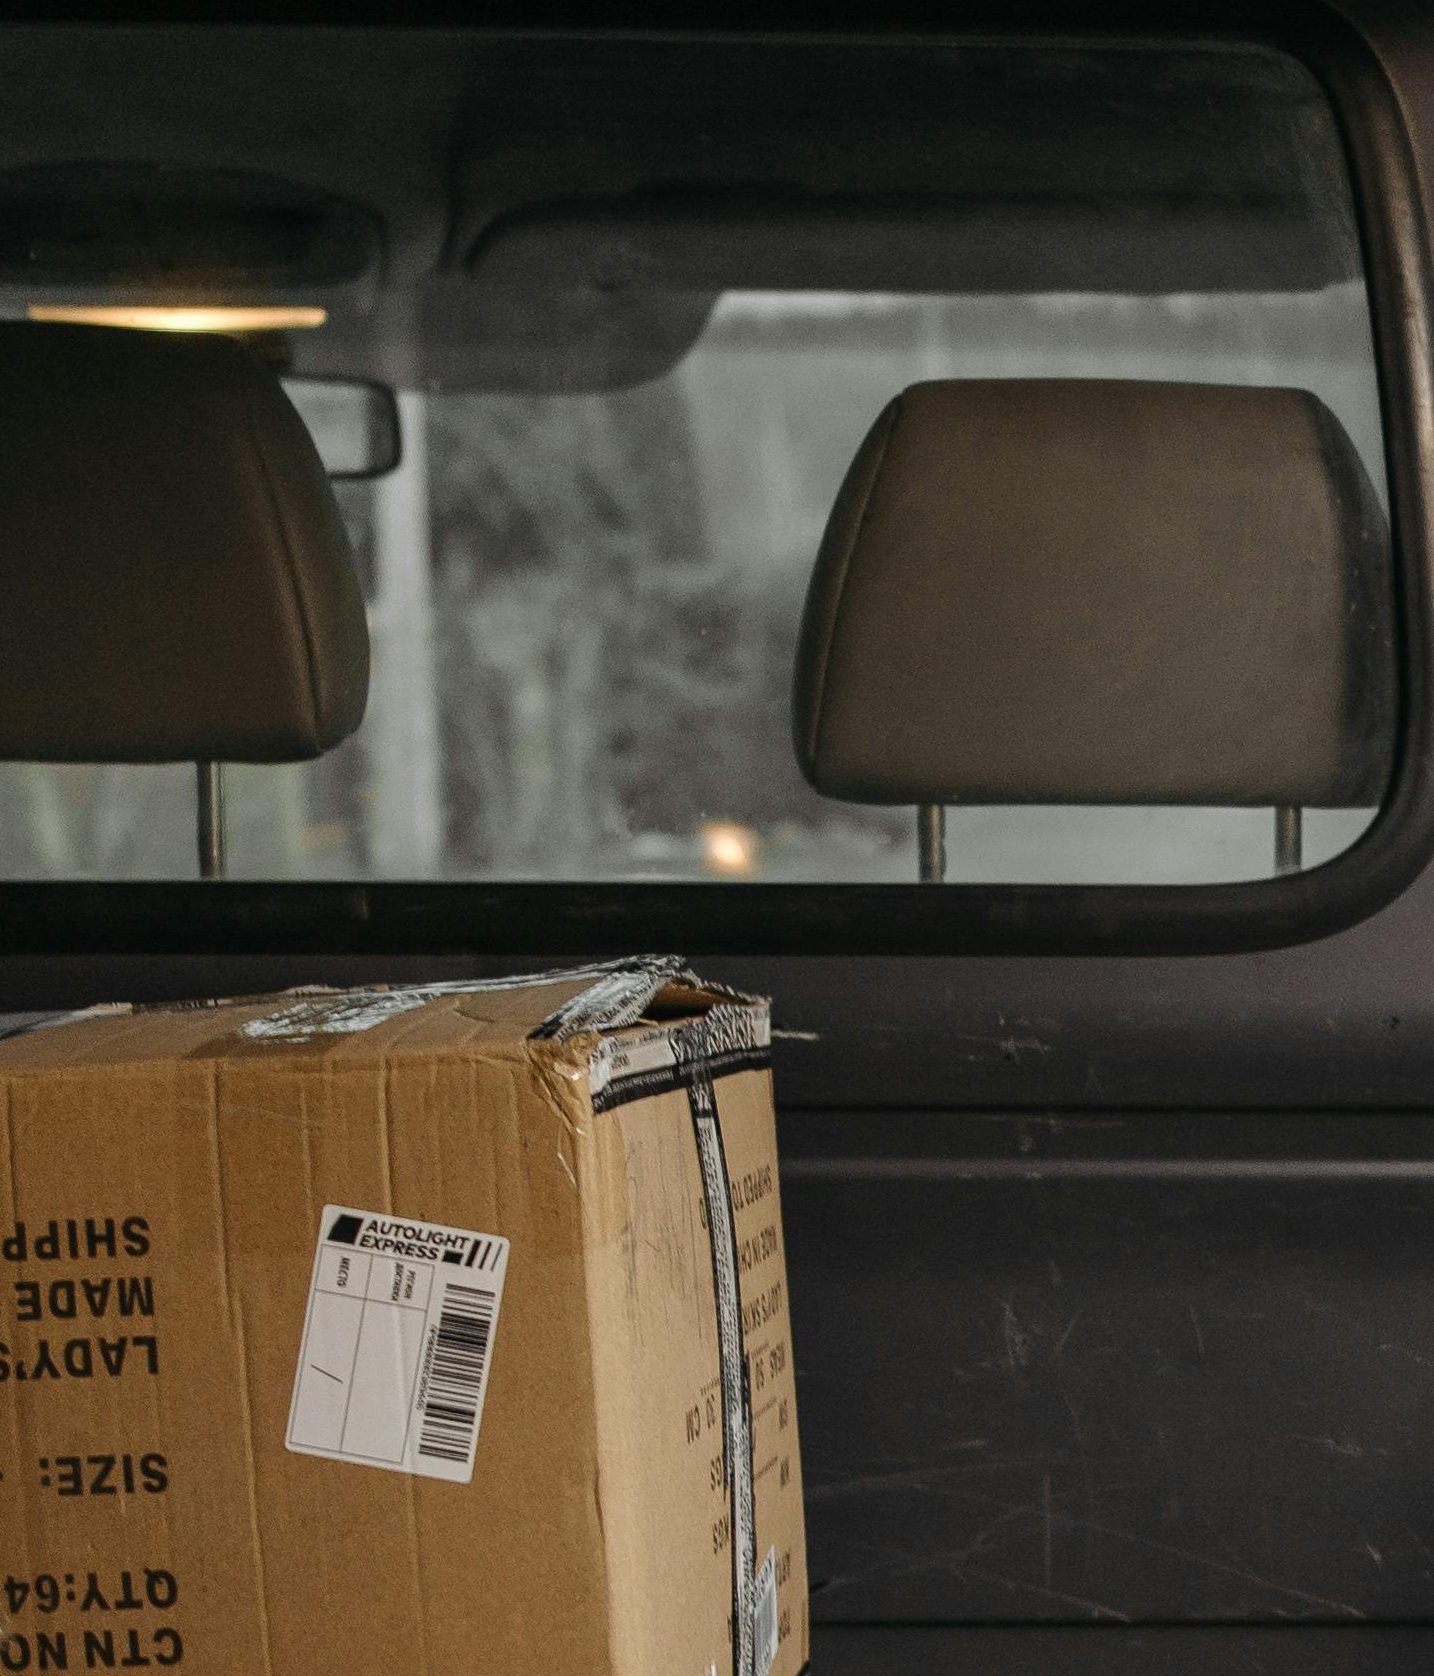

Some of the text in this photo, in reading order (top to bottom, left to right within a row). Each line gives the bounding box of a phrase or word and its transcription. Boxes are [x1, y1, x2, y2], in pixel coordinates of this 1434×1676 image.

[359, 1237, 439, 1260] EXPRESS
[365, 1220, 470, 1249] AUTOLIGHT
[14, 1276, 155, 1322] MADE
[38, 1454, 168, 1497] SIZE:
[3, 1568, 178, 1613] QTY:64
[83, 1627, 184, 1669] CTN
